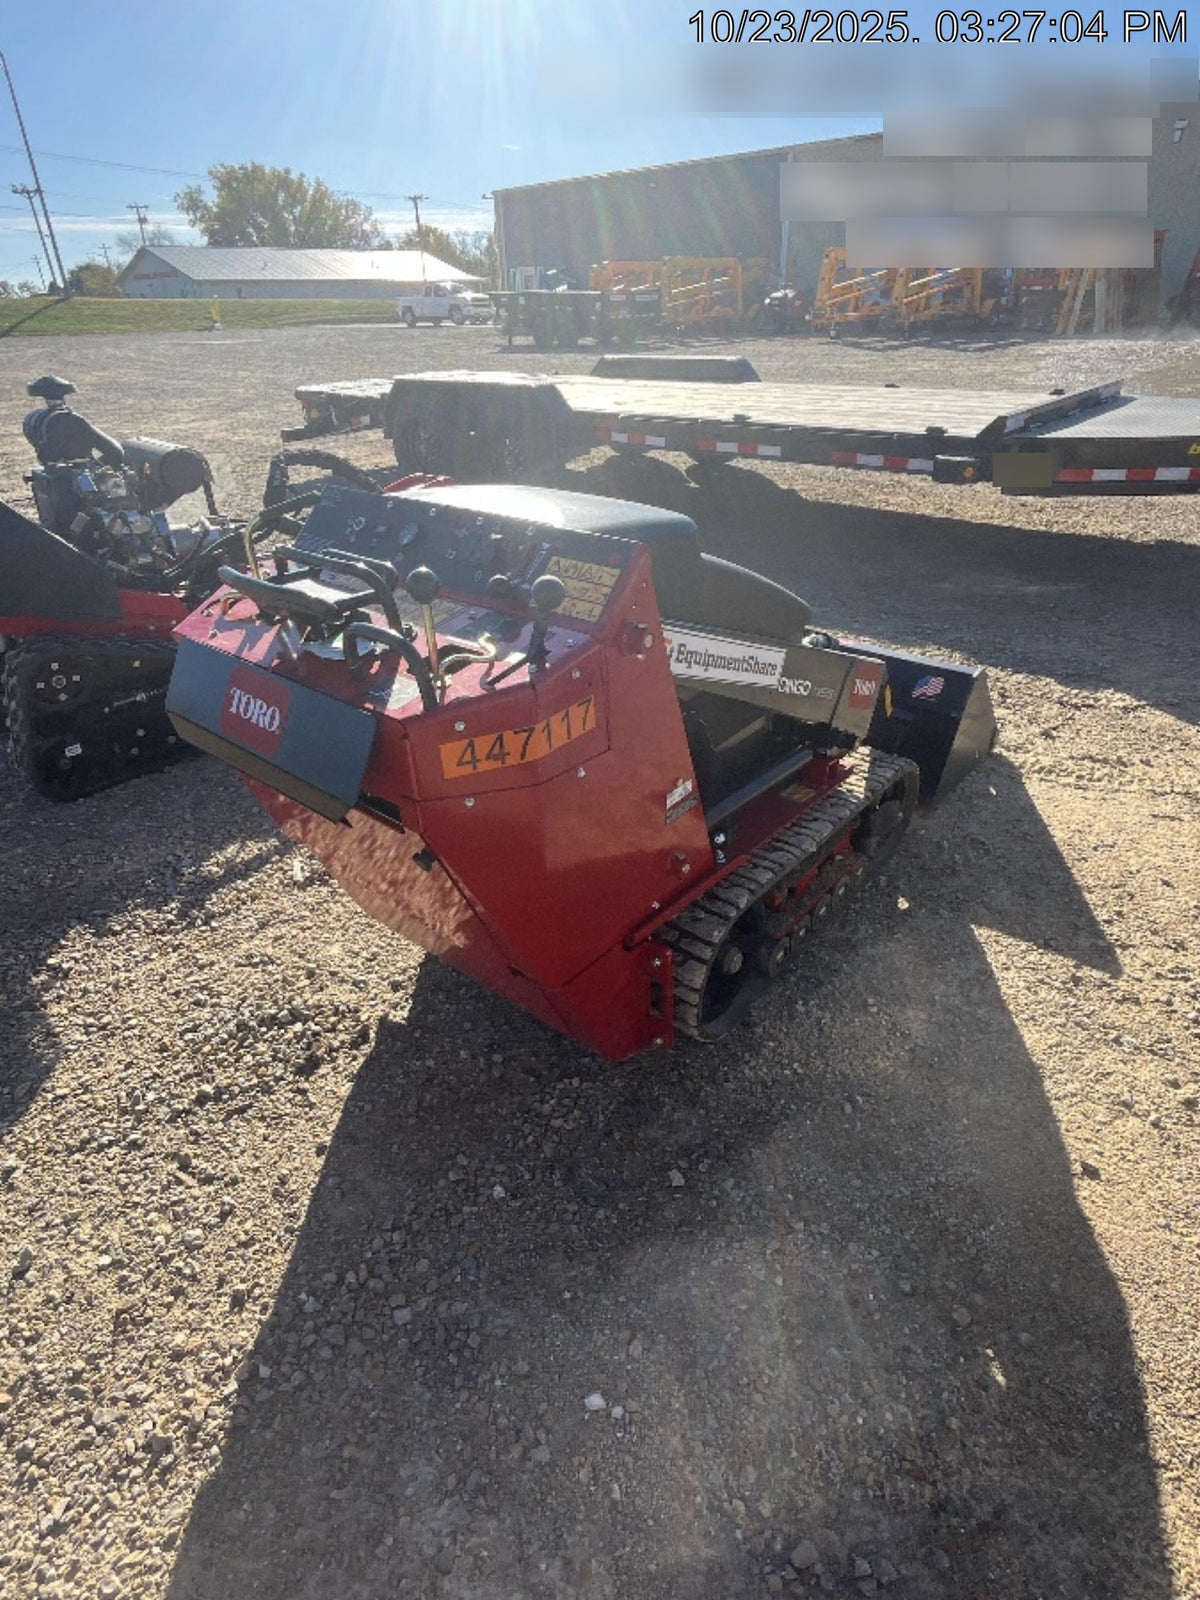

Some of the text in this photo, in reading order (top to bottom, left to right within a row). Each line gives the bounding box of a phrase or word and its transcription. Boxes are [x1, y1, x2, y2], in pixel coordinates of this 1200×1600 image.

[675, 642, 778, 677] EquipmentShare
[228, 687, 281, 732] TORO
[456, 697, 593, 771] 447117
